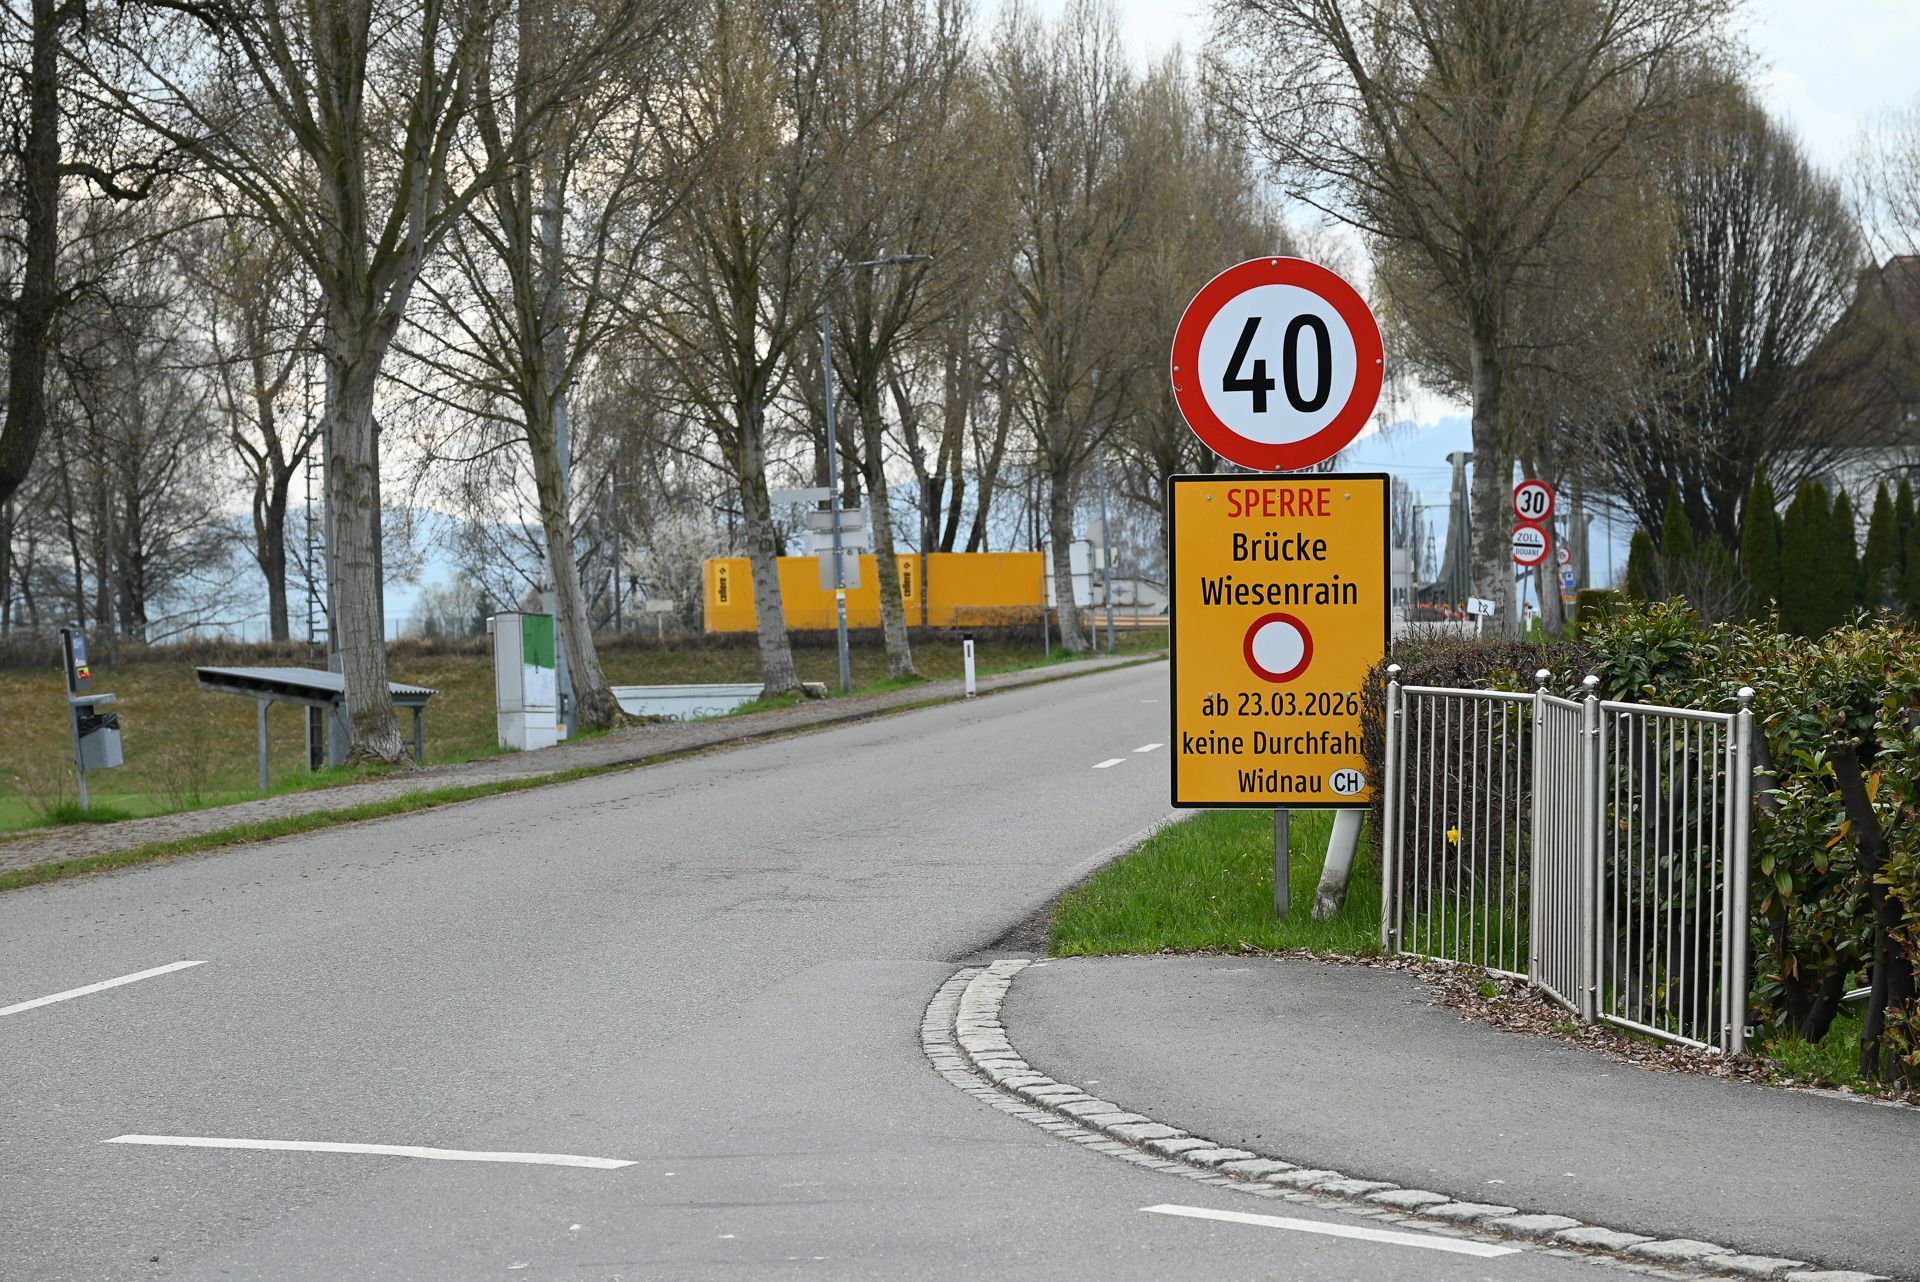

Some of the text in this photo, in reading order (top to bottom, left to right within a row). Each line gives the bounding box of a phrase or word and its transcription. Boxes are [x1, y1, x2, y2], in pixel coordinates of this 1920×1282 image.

[1222, 313, 1332, 413] 40
[1227, 488, 1331, 518] SPERRE
[1521, 490, 1544, 513] 30
[1233, 531, 1327, 562] Brücke
[1516, 532, 1540, 543] ZOLL
[1201, 574, 1358, 606] Wiesenrain
[1202, 692, 1359, 717] ab 23.03.2026
[1183, 730, 1244, 755] keine
[1238, 768, 1359, 793] Widnau CH
